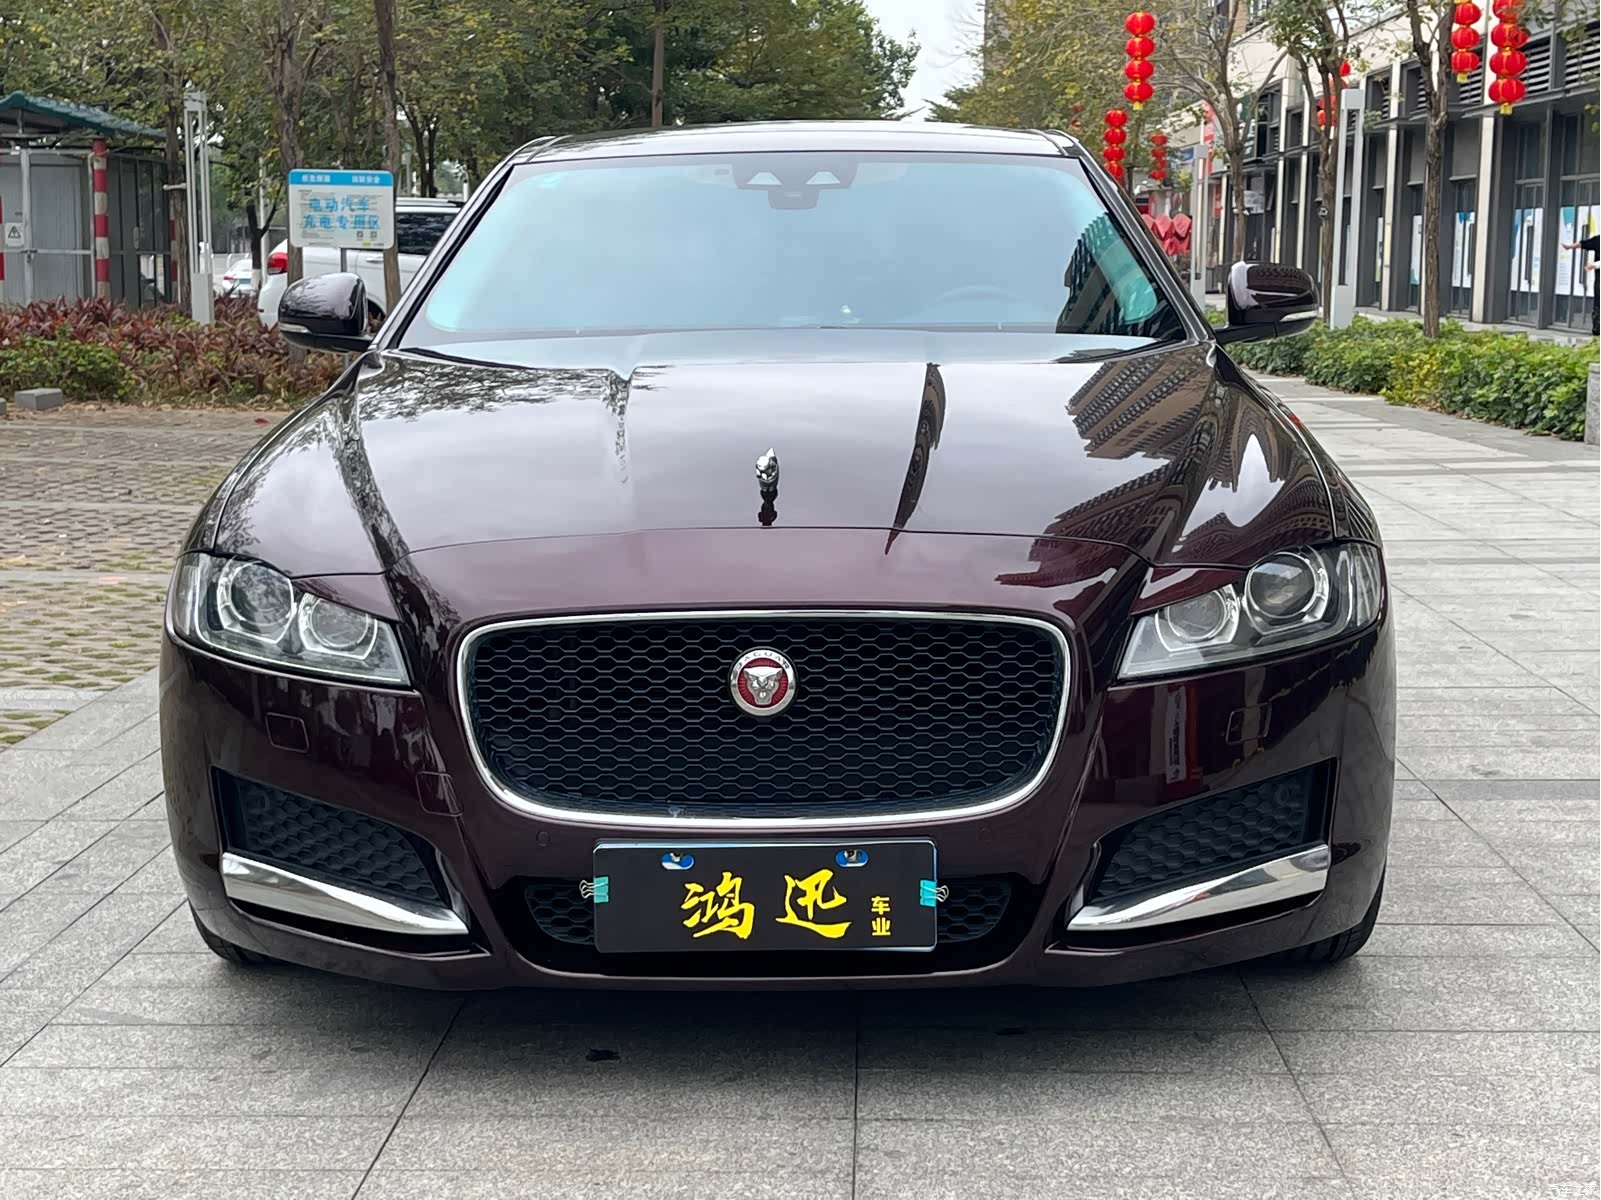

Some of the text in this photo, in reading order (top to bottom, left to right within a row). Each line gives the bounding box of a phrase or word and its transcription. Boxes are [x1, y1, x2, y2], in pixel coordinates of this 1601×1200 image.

[309, 196, 369, 212] 电动汽车
[304, 214, 380, 230] 充电专用区
[871, 896, 891, 936] 车业
